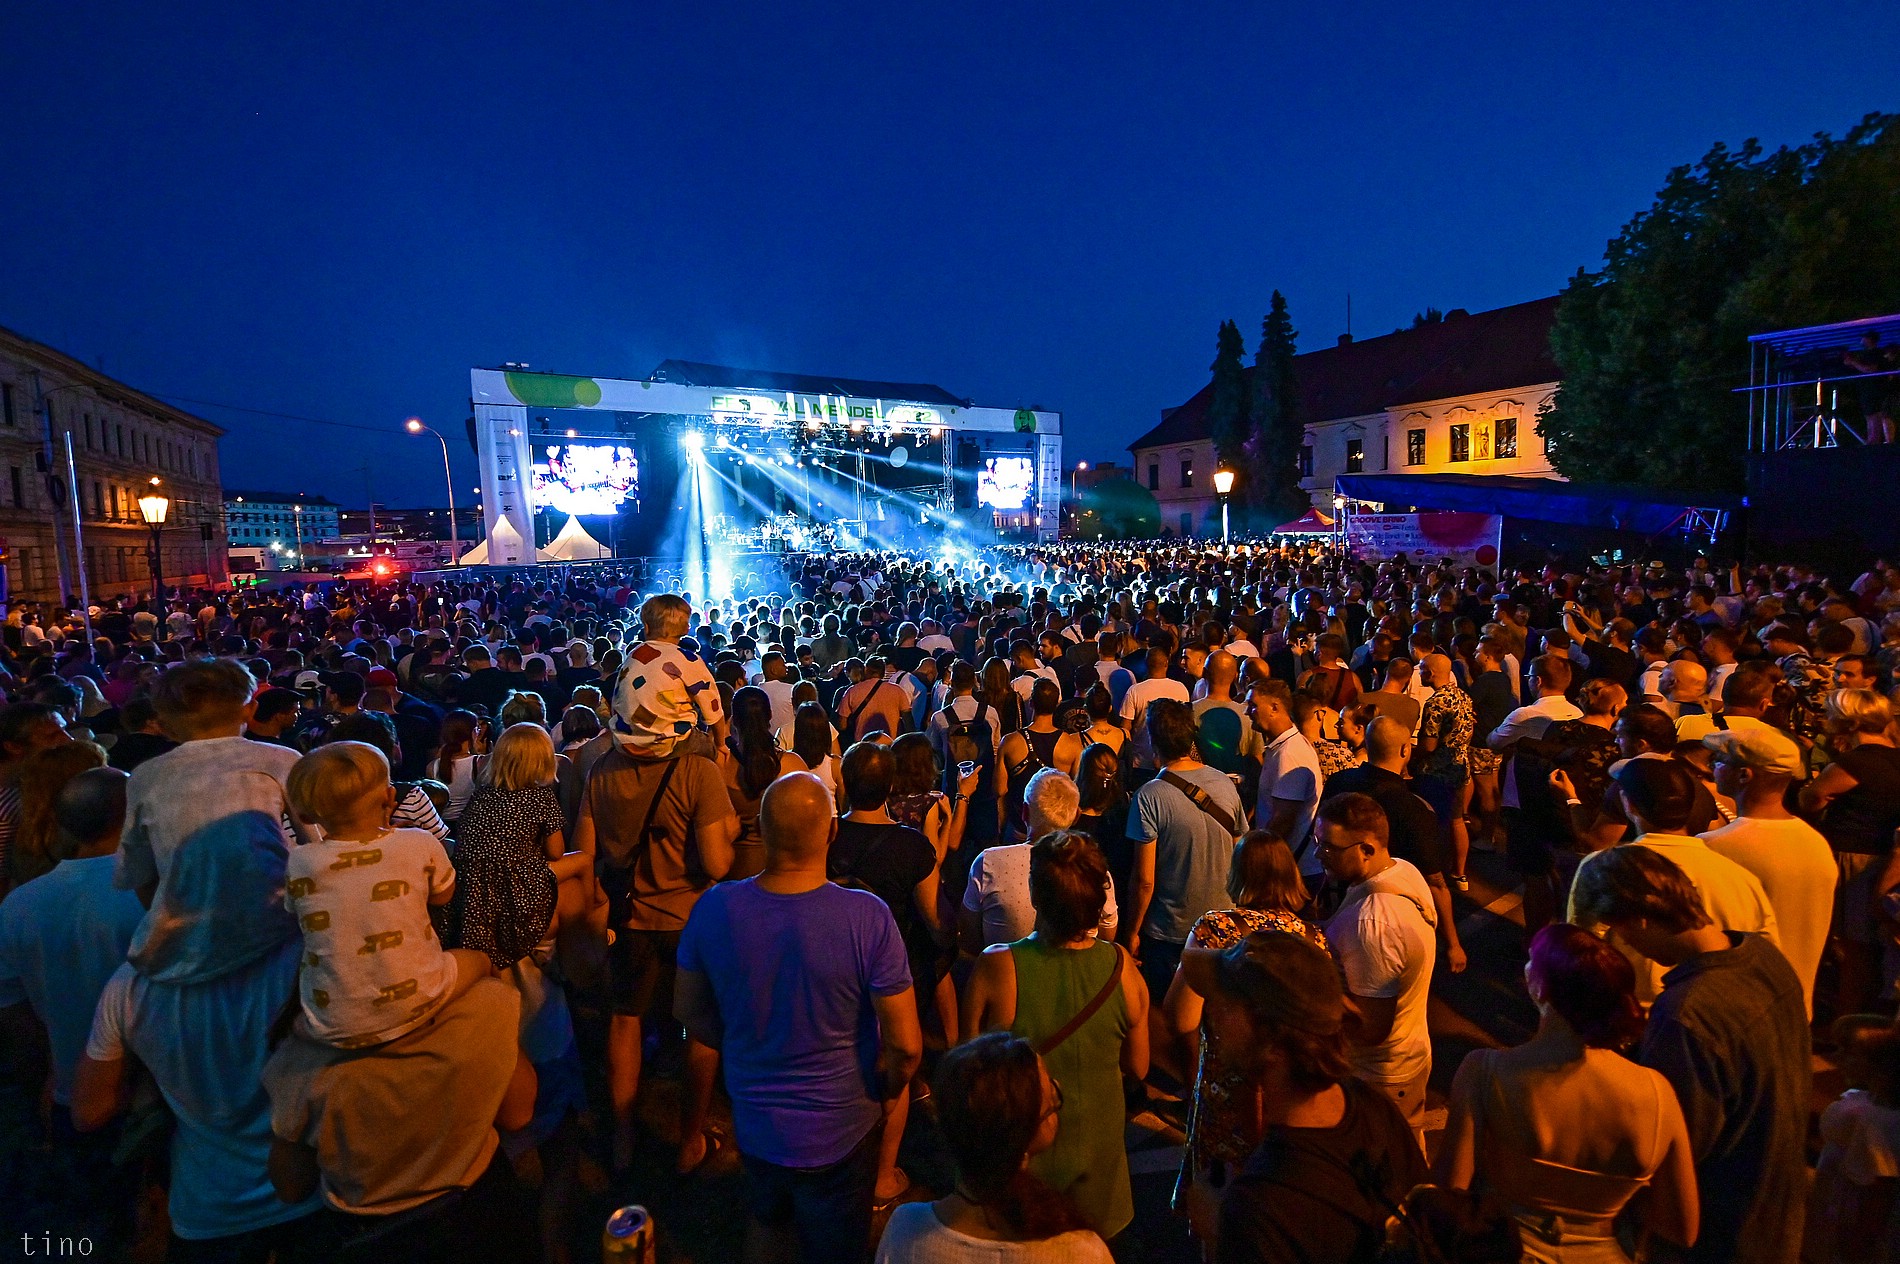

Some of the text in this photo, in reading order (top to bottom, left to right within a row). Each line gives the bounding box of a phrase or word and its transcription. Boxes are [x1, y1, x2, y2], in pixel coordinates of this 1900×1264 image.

[812, 403, 885, 419] MENDEL
[1350, 516, 1407, 524] GROOVE BRNO
